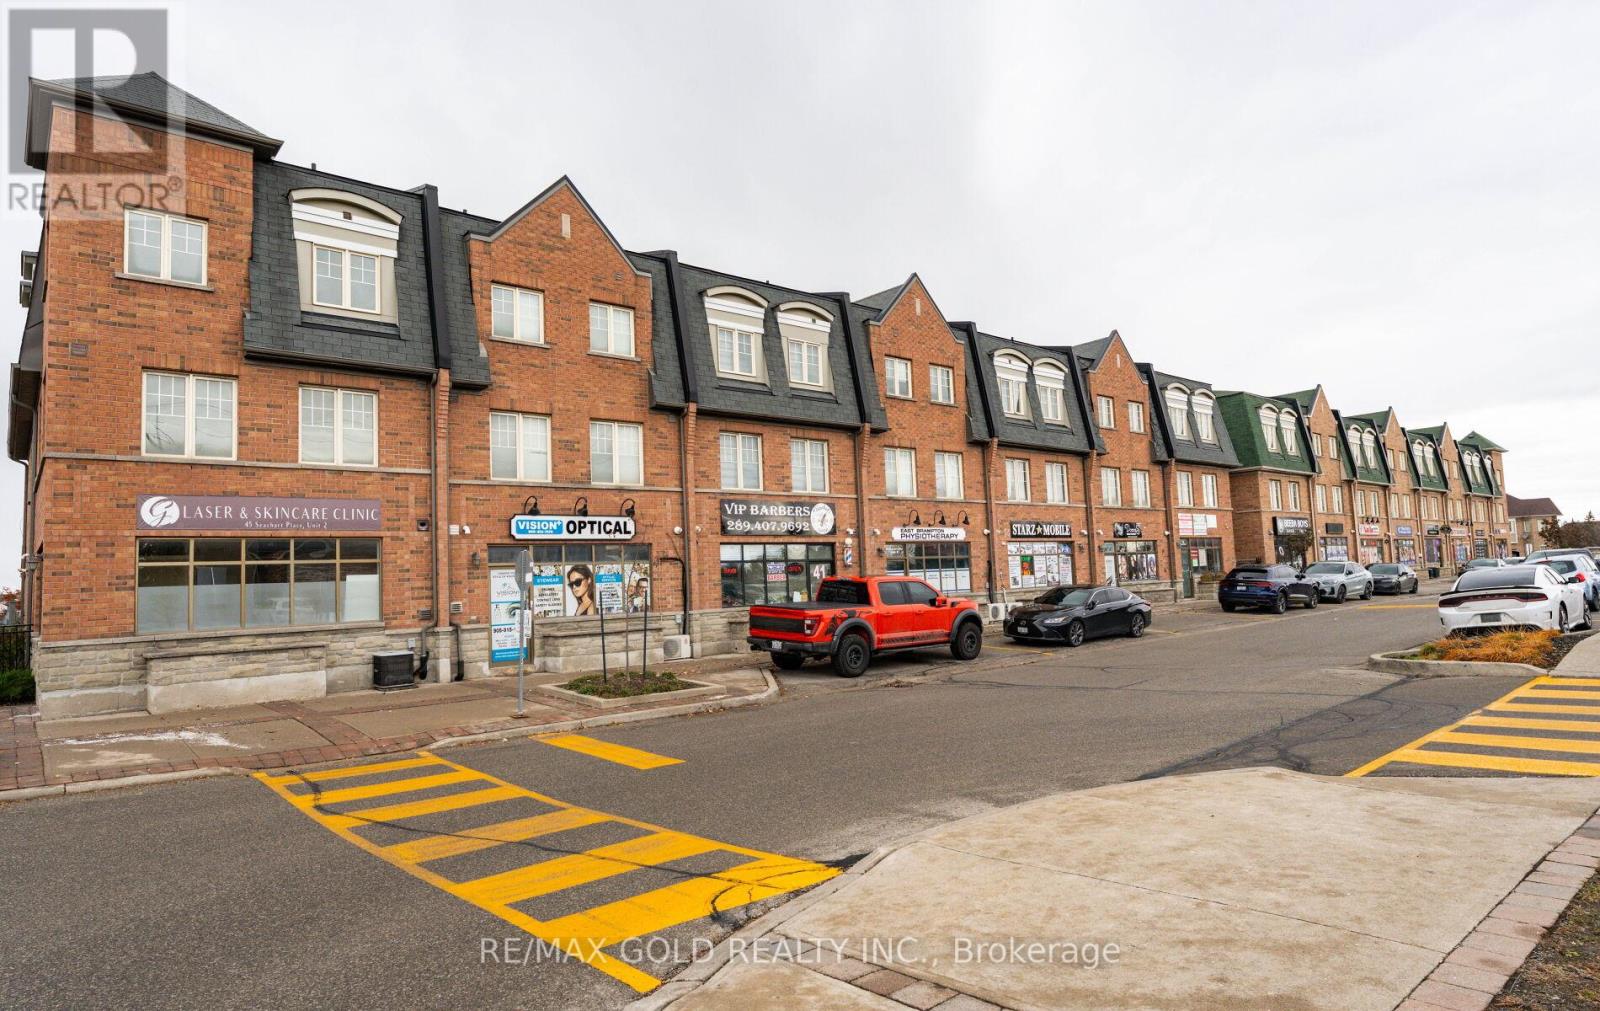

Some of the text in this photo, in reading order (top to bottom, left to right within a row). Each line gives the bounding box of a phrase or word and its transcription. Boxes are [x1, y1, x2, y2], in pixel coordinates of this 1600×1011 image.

[183, 505, 379, 521] LASER & SKINCARE CLINIC
[724, 503, 747, 515] VIP
[750, 505, 811, 517] BARBERS
[566, 520, 632, 535] OPTICAL
[727, 519, 811, 533] 289.407.9692
[1012, 523, 1071, 536] STARZ MOBILE
[813, 564, 826, 580] 41
